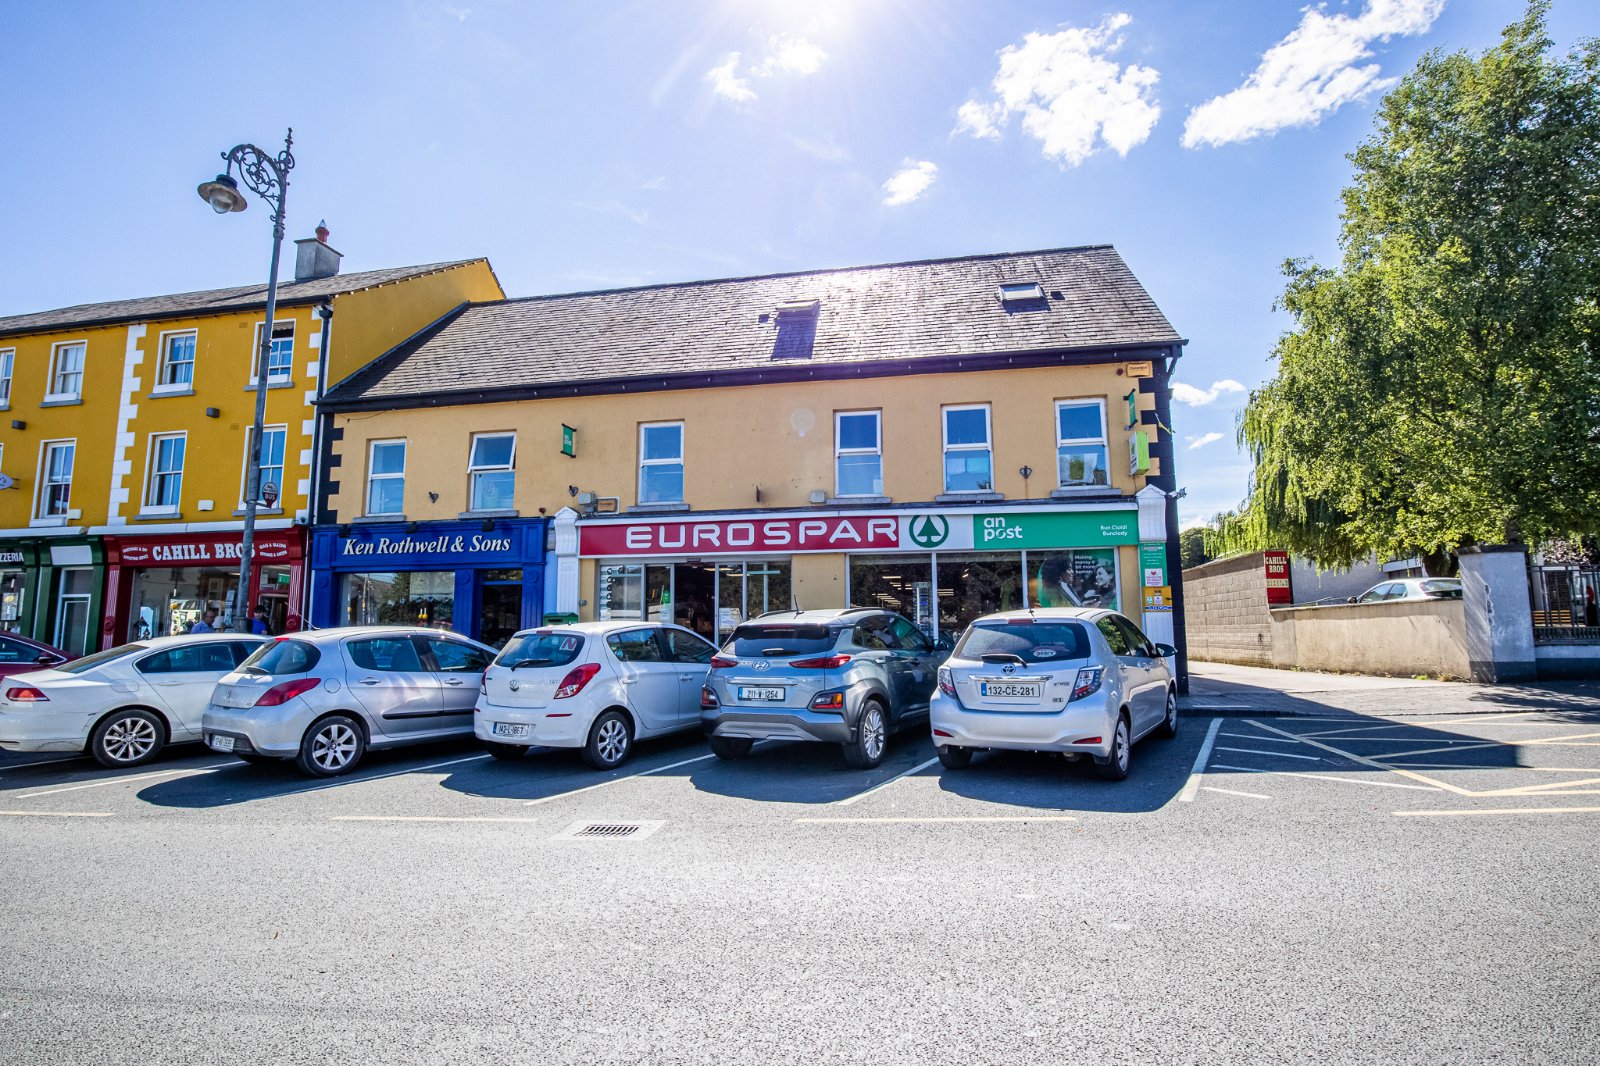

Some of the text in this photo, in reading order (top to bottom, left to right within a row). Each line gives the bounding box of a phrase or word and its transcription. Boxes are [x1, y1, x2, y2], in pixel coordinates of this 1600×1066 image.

[983, 517, 1006, 528] an
[625, 518, 899, 549] EUROSPAR
[984, 525, 1023, 542] post
[342, 534, 511, 555] Ken Rothwell & Sons
[152, 544, 211, 560] CAHILL
[1269, 564, 1284, 573] BROS
[747, 690, 779, 699] 211-W-1254
[988, 686, 1035, 696] 132-CE-281
